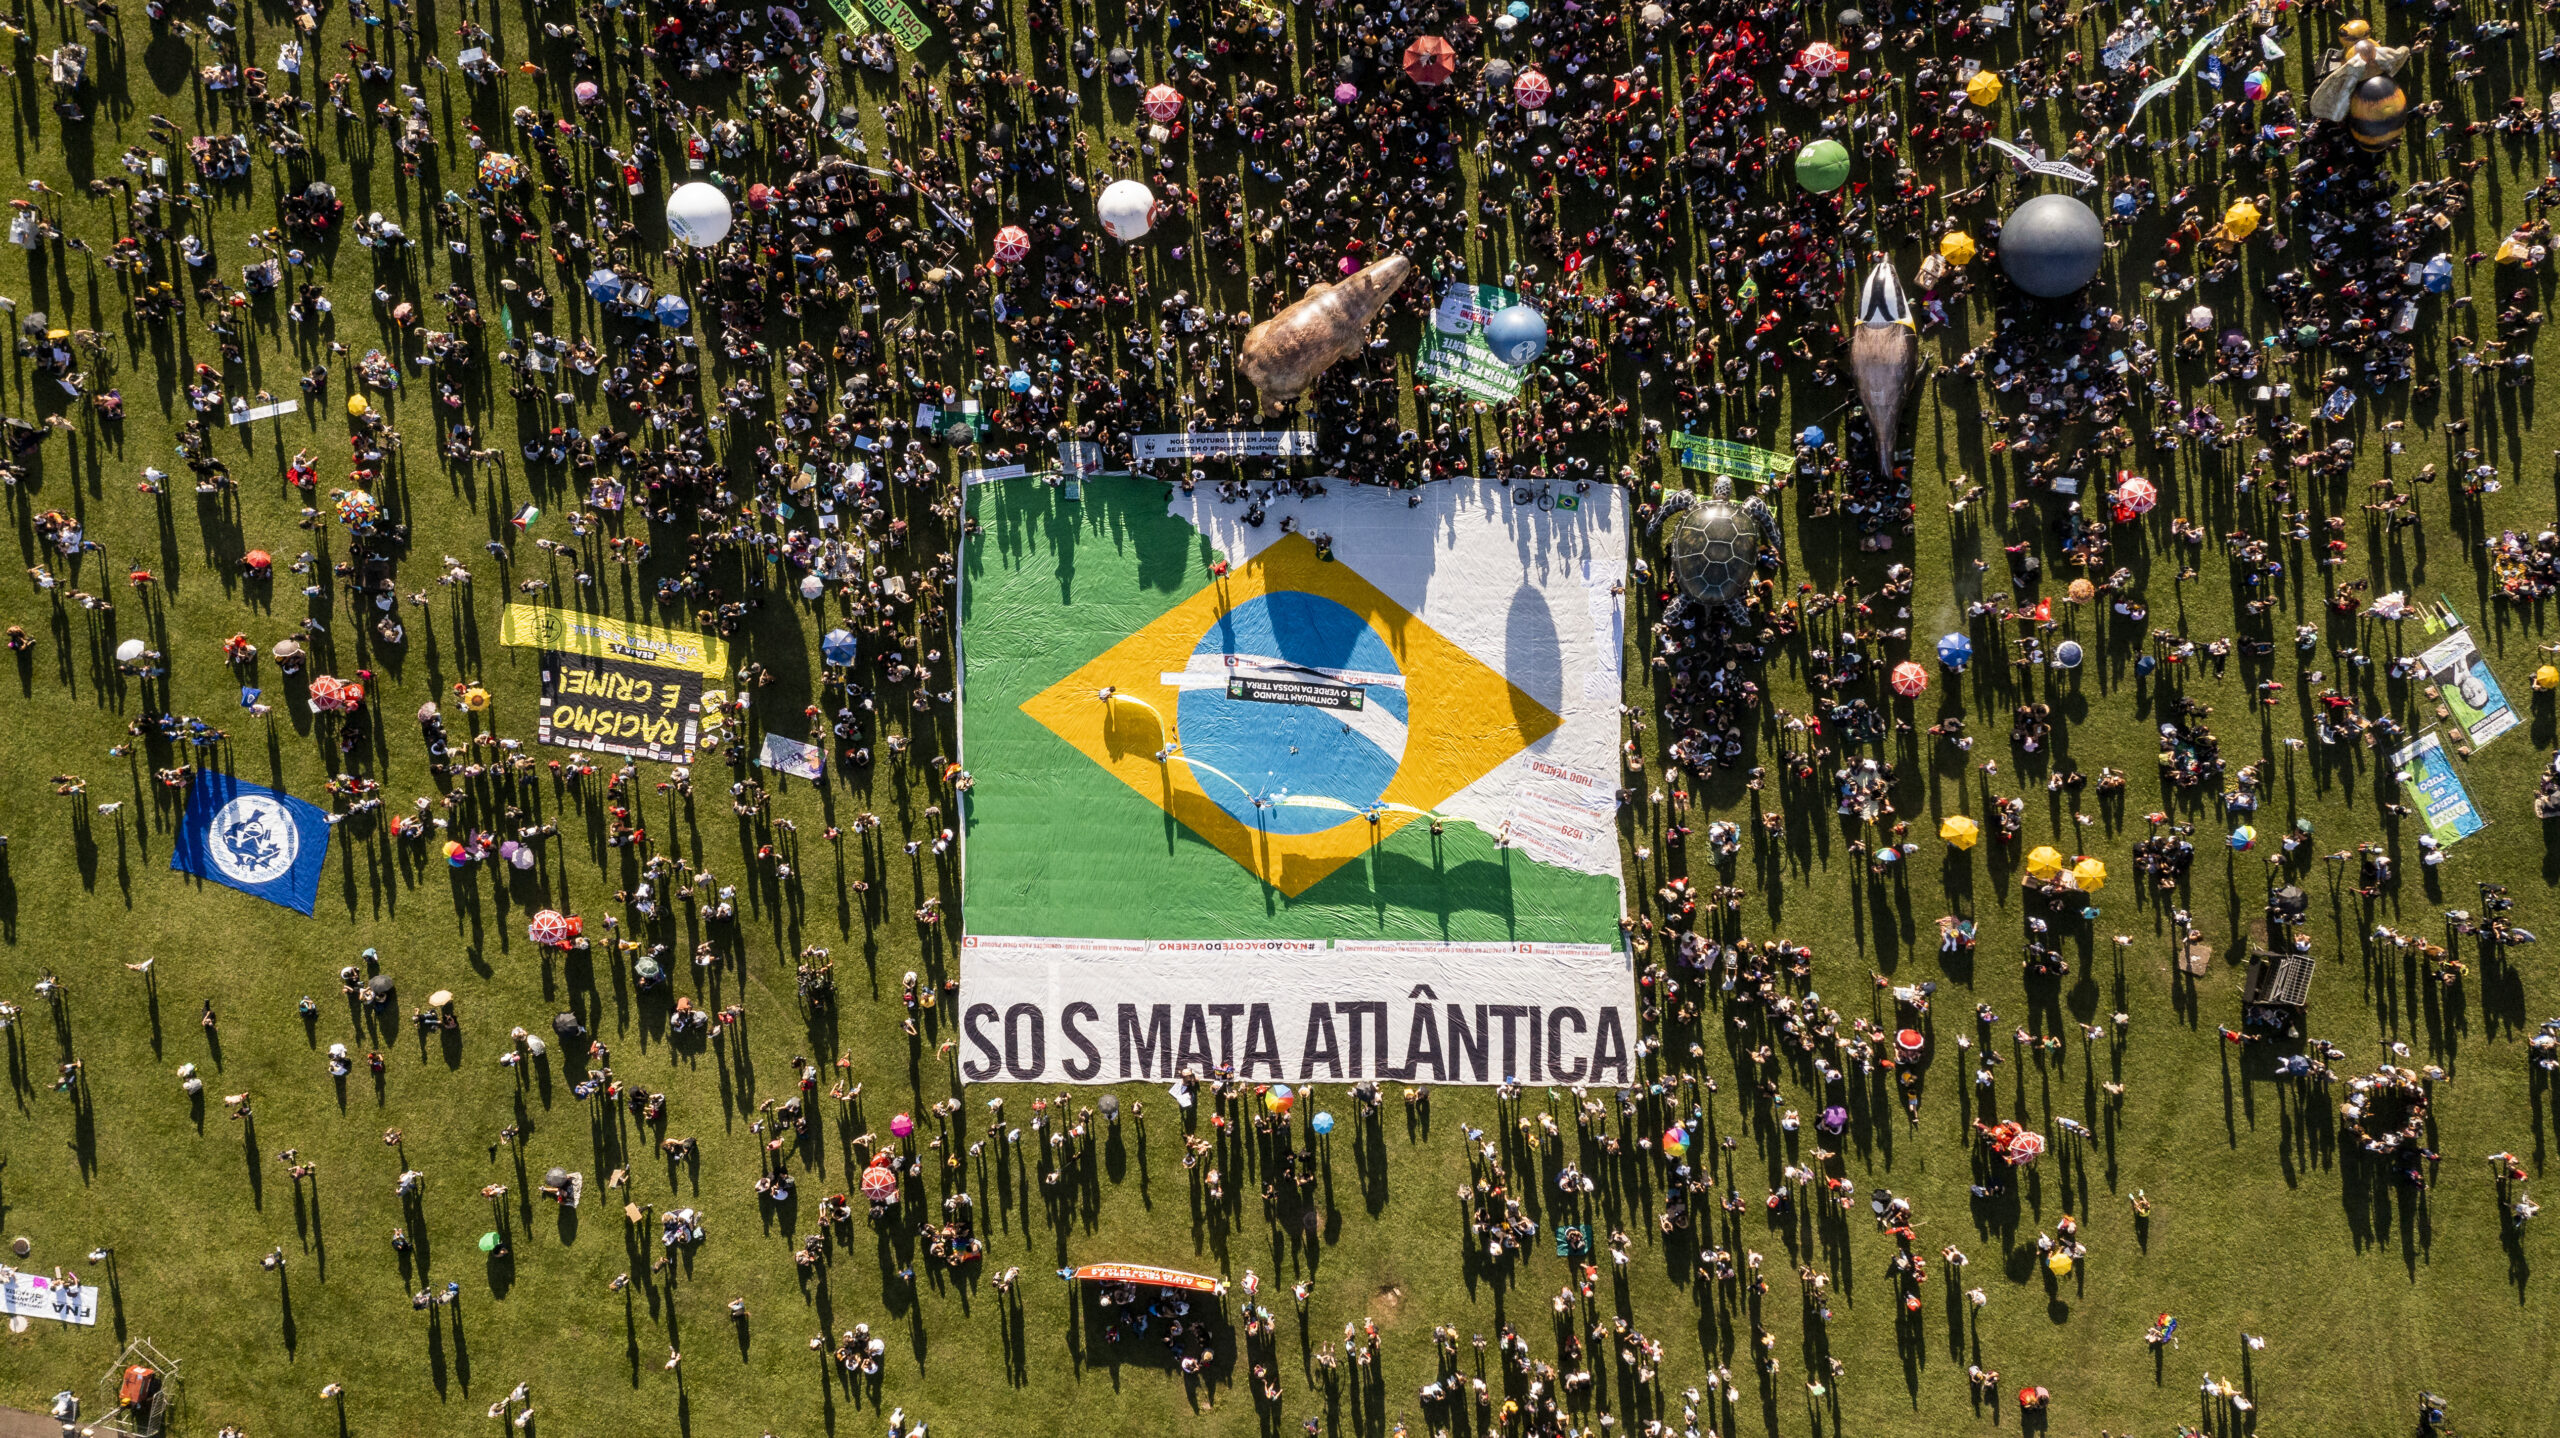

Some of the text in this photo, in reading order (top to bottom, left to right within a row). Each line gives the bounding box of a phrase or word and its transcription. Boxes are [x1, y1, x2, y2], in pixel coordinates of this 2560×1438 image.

[897, 5, 929, 42] FORA
[890, 18, 917, 48] PELA
[613, 643, 623, 655] À
[625, 635, 698, 657] VIOLÊNCIA
[557, 664, 680, 719] É CRIME!
[1245, 680, 1271, 689] TERRA
[1272, 682, 1300, 692] NOSSA
[1300, 685, 1312, 693] DA
[1314, 686, 1339, 696] VERDE
[1253, 689, 1288, 701] TIRANDO
[1290, 693, 1338, 706] CONTINUAM
[551, 702, 679, 745] RACISMO
[1531, 760, 1567, 779] VENENO
[1568, 772, 1593, 787] TUDO
[2418, 771, 2446, 791] TUDO
[2430, 785, 2445, 799] DE
[2427, 792, 2459, 814] ACIMA
[1560, 824, 1583, 840] 1629
[1118, 1002, 1283, 1081] MATA
[1300, 984, 1630, 1083] ATLÂNTICA
[52, 1302, 90, 1317] FNA
